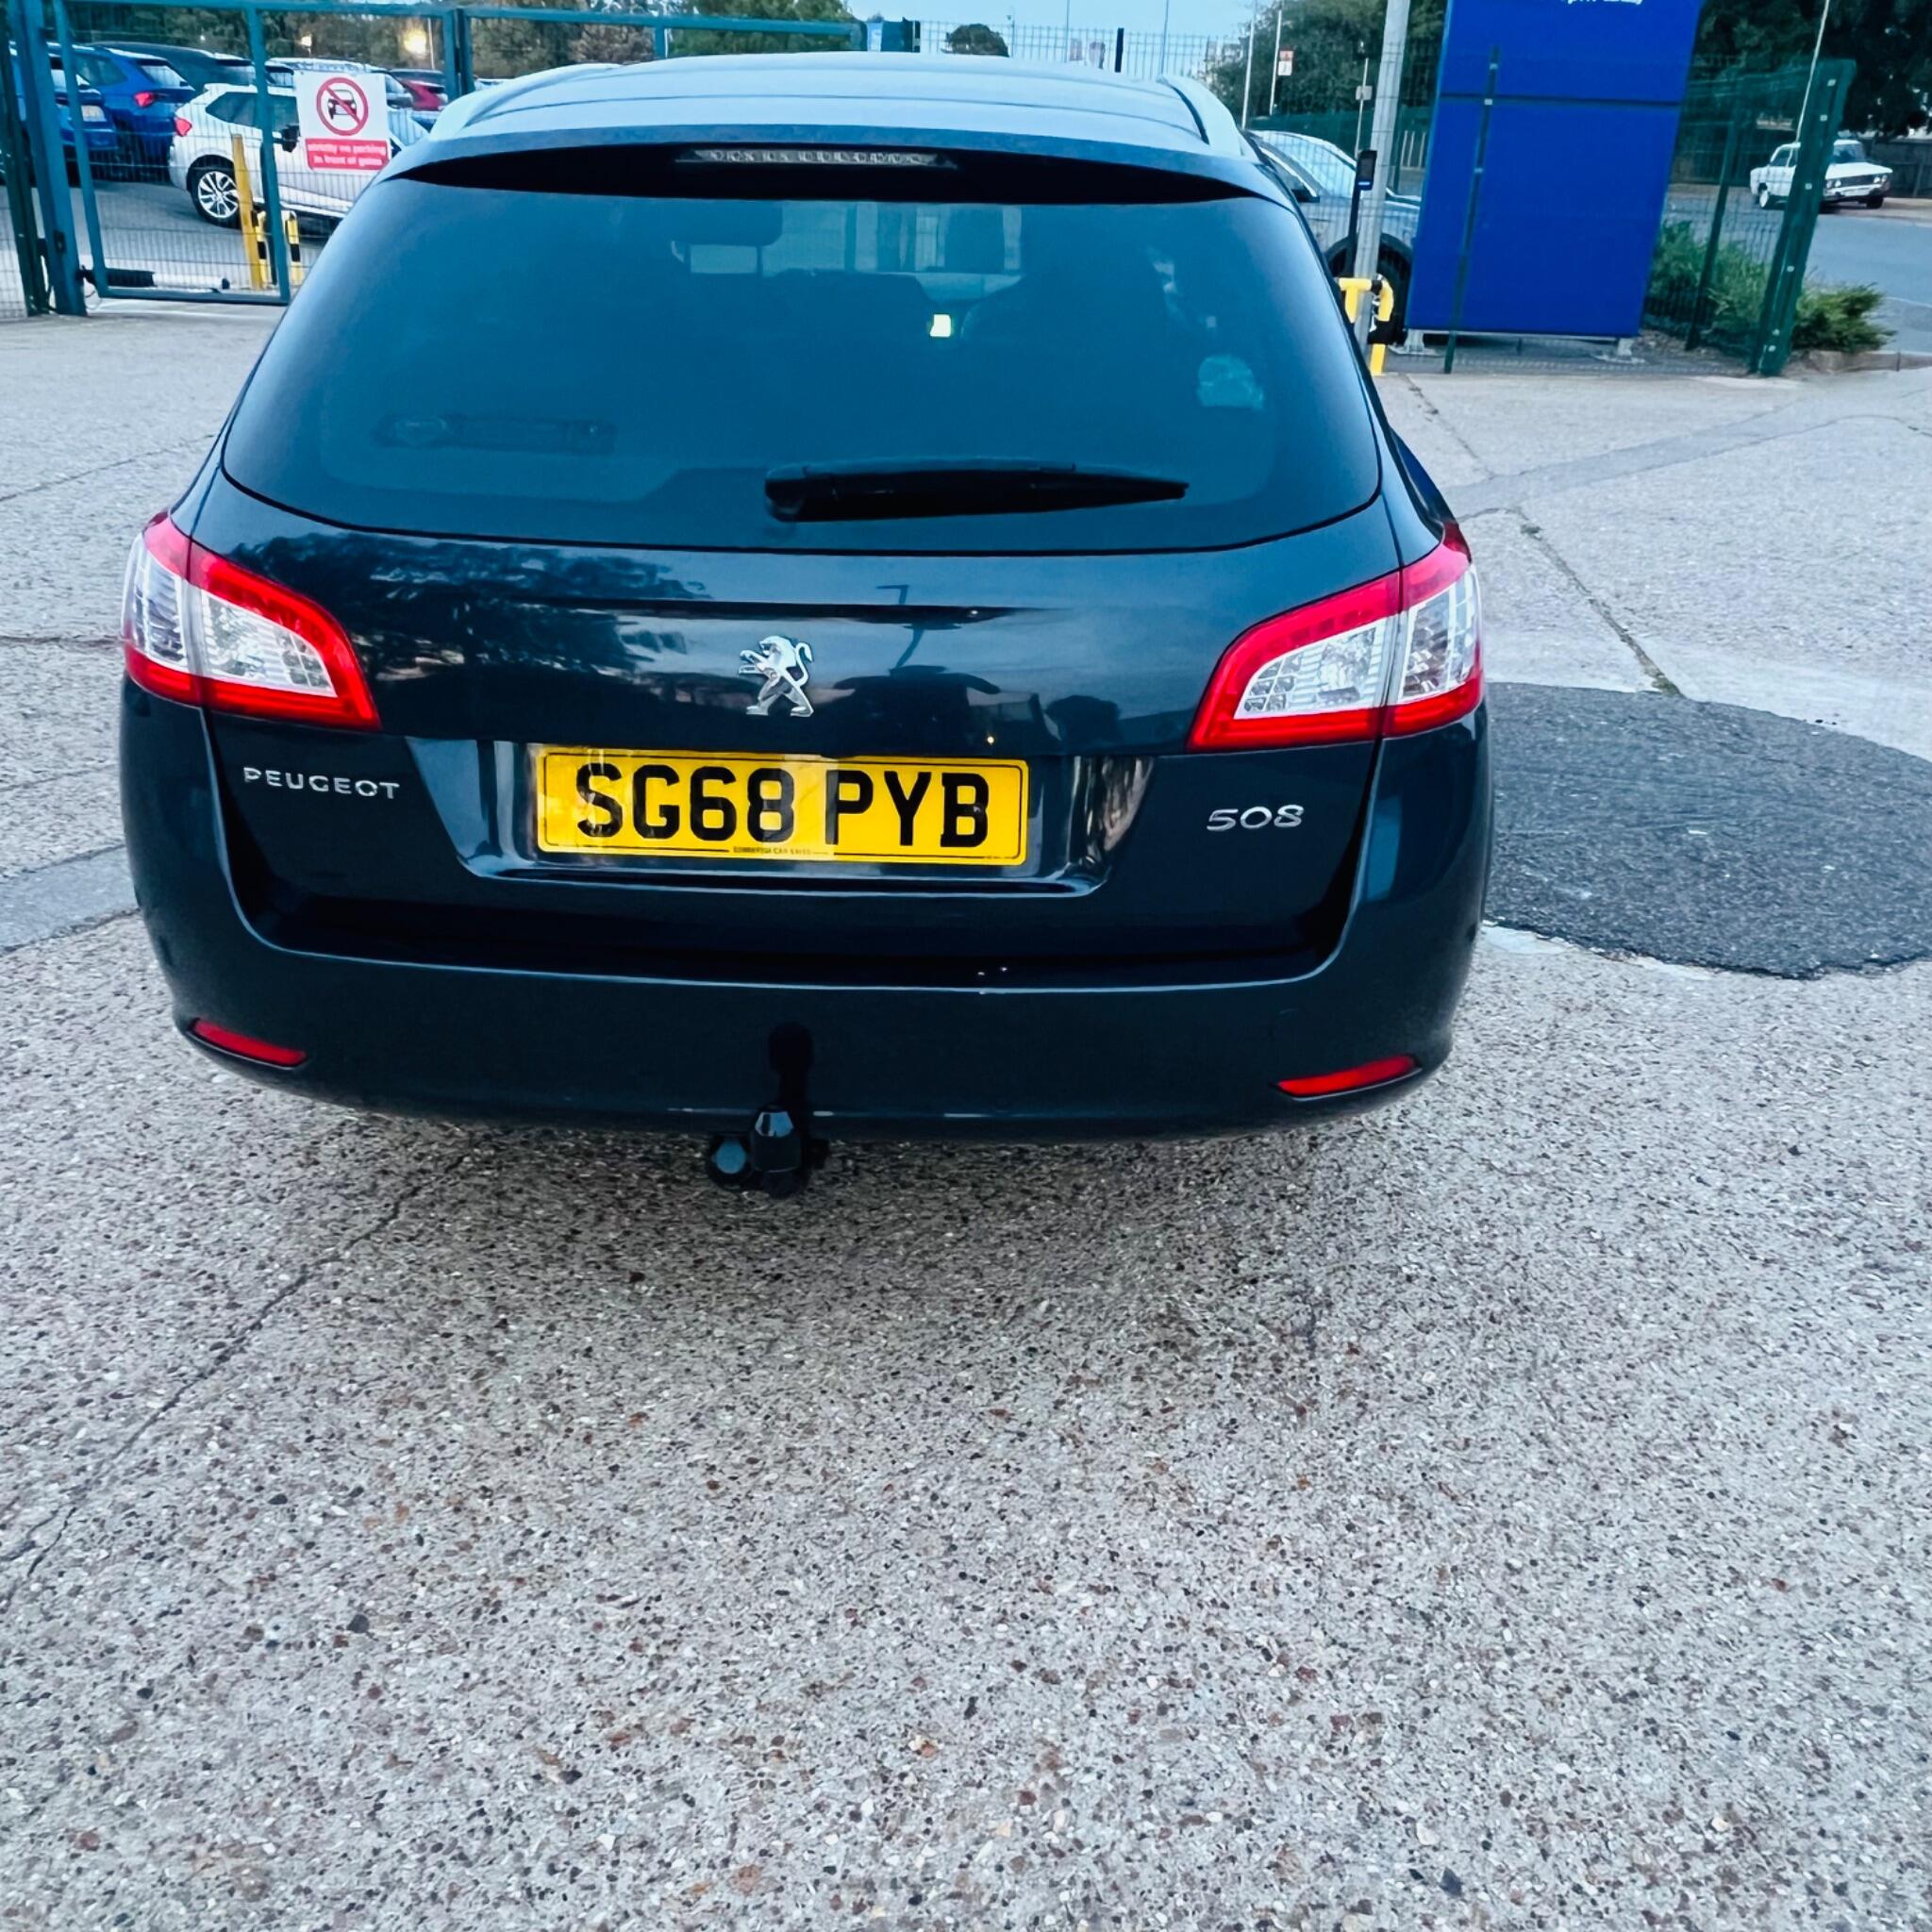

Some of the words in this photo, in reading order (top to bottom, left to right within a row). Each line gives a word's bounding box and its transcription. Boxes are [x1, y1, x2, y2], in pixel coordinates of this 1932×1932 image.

[242, 766, 401, 800] PEUGEOT
[575, 762, 795, 842] SG68
[824, 769, 991, 848] PYB
[1207, 804, 1305, 831] 508
